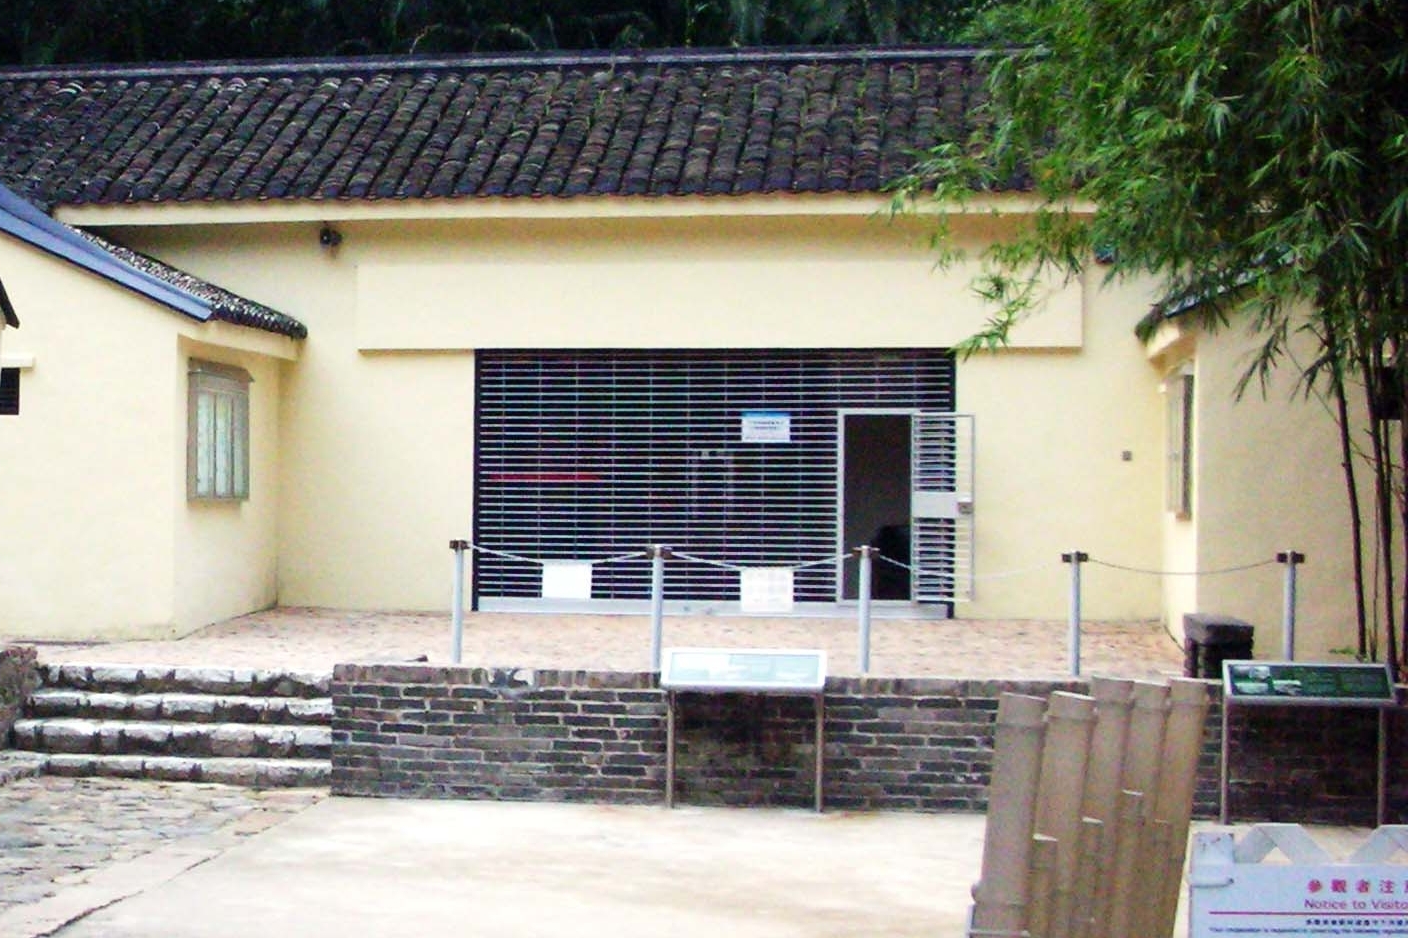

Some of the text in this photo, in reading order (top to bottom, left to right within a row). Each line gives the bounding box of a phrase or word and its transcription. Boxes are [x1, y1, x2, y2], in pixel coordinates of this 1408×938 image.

[1308, 879, 1408, 894] 參觀者注
[1304, 899, 1347, 910] Notice
[1352, 900, 1367, 910] to
